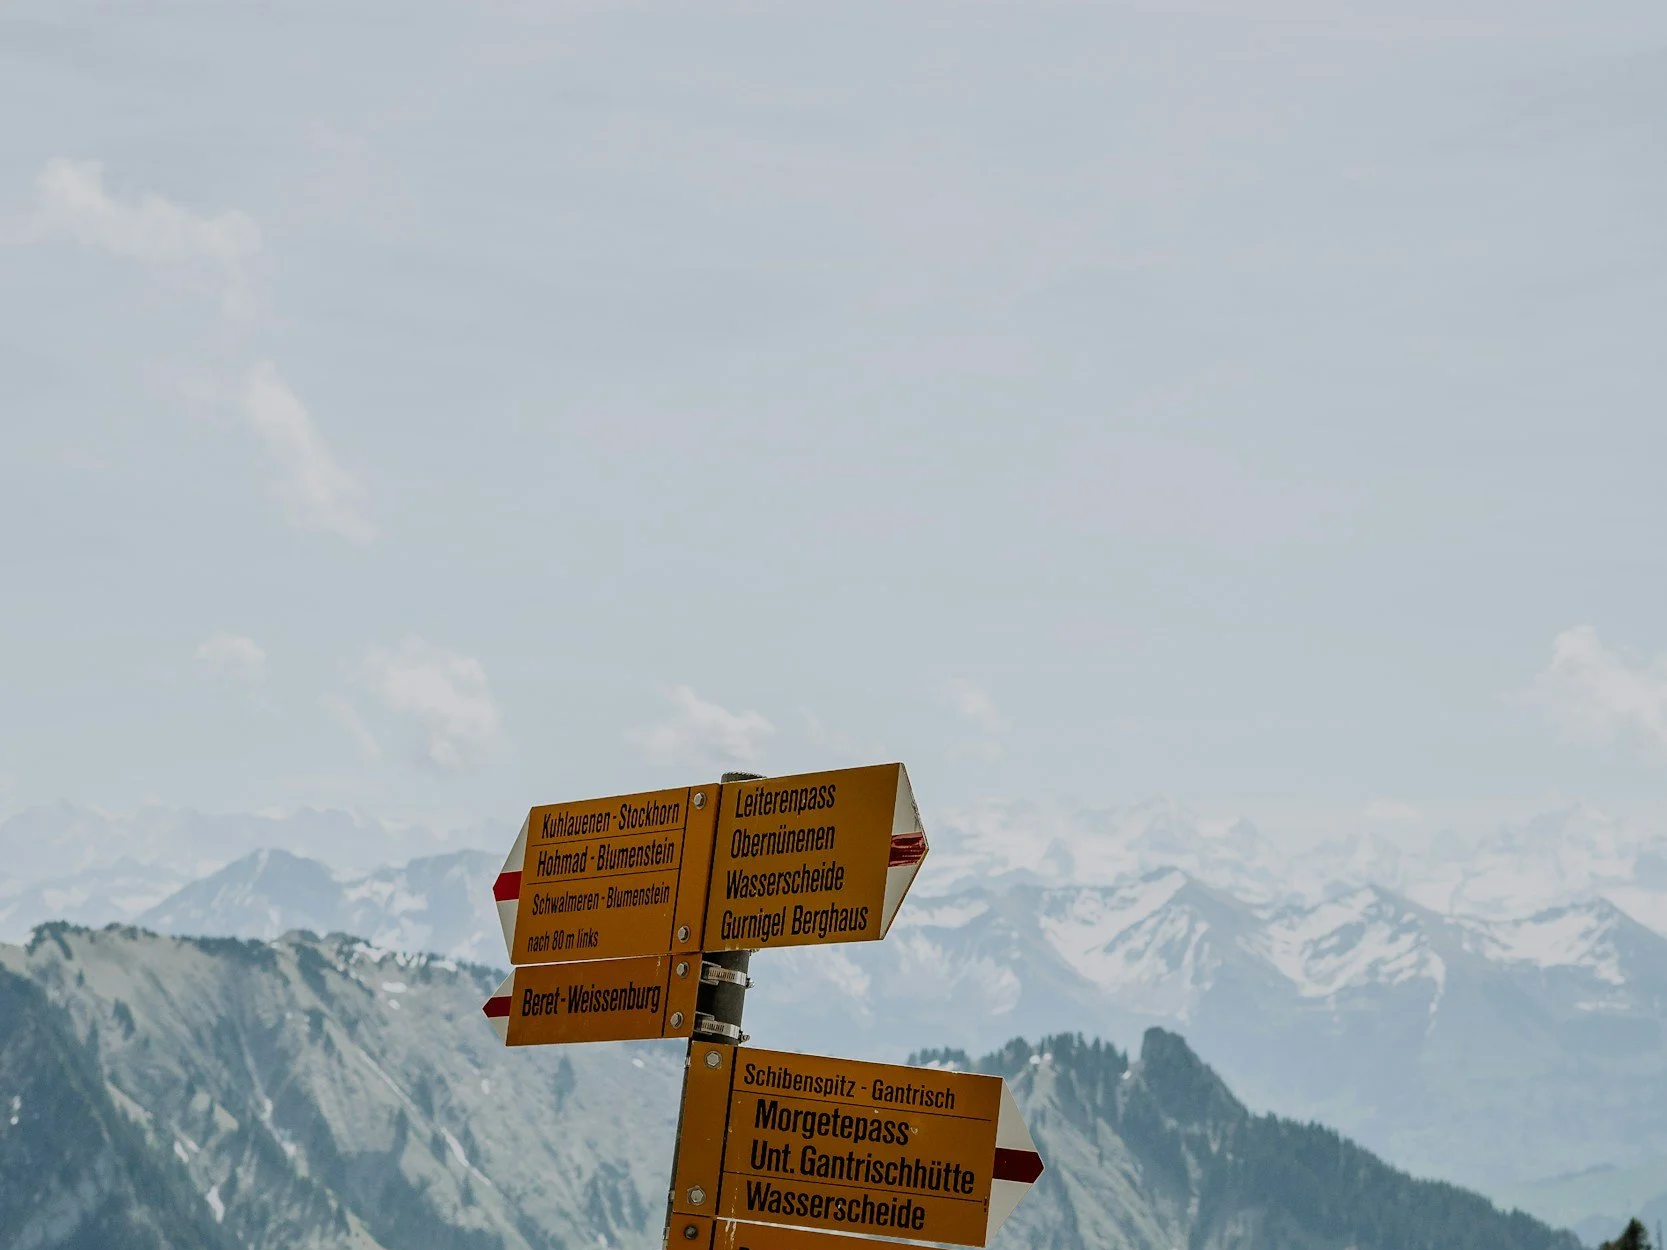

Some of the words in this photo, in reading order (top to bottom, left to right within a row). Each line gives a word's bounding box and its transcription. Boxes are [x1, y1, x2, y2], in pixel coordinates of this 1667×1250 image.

[541, 811, 610, 839] Kuhlauenen
[618, 800, 680, 830] Stockhorn
[735, 784, 836, 818] Leiterenpass
[537, 846, 589, 877] Hohmad
[597, 837, 675, 871] Blumenstein
[730, 825, 835, 858] Obernünenen
[532, 891, 600, 916] Schwalmeren
[606, 881, 670, 909] Blumenstein
[726, 861, 845, 899] Wasserscheide
[527, 931, 550, 952] nach
[576, 927, 599, 949] links
[721, 906, 787, 942] Gurnigel
[791, 902, 869, 938] Berghaus
[744, 1063, 856, 1098] Schibenspitz
[871, 1079, 956, 1110] Gantrisch
[754, 1098, 910, 1146] Morgetepass
[750, 1139, 795, 1174] Unt.
[800, 1145, 975, 1195] Gantrischhütte
[746, 1180, 926, 1230] Wasserscheide
